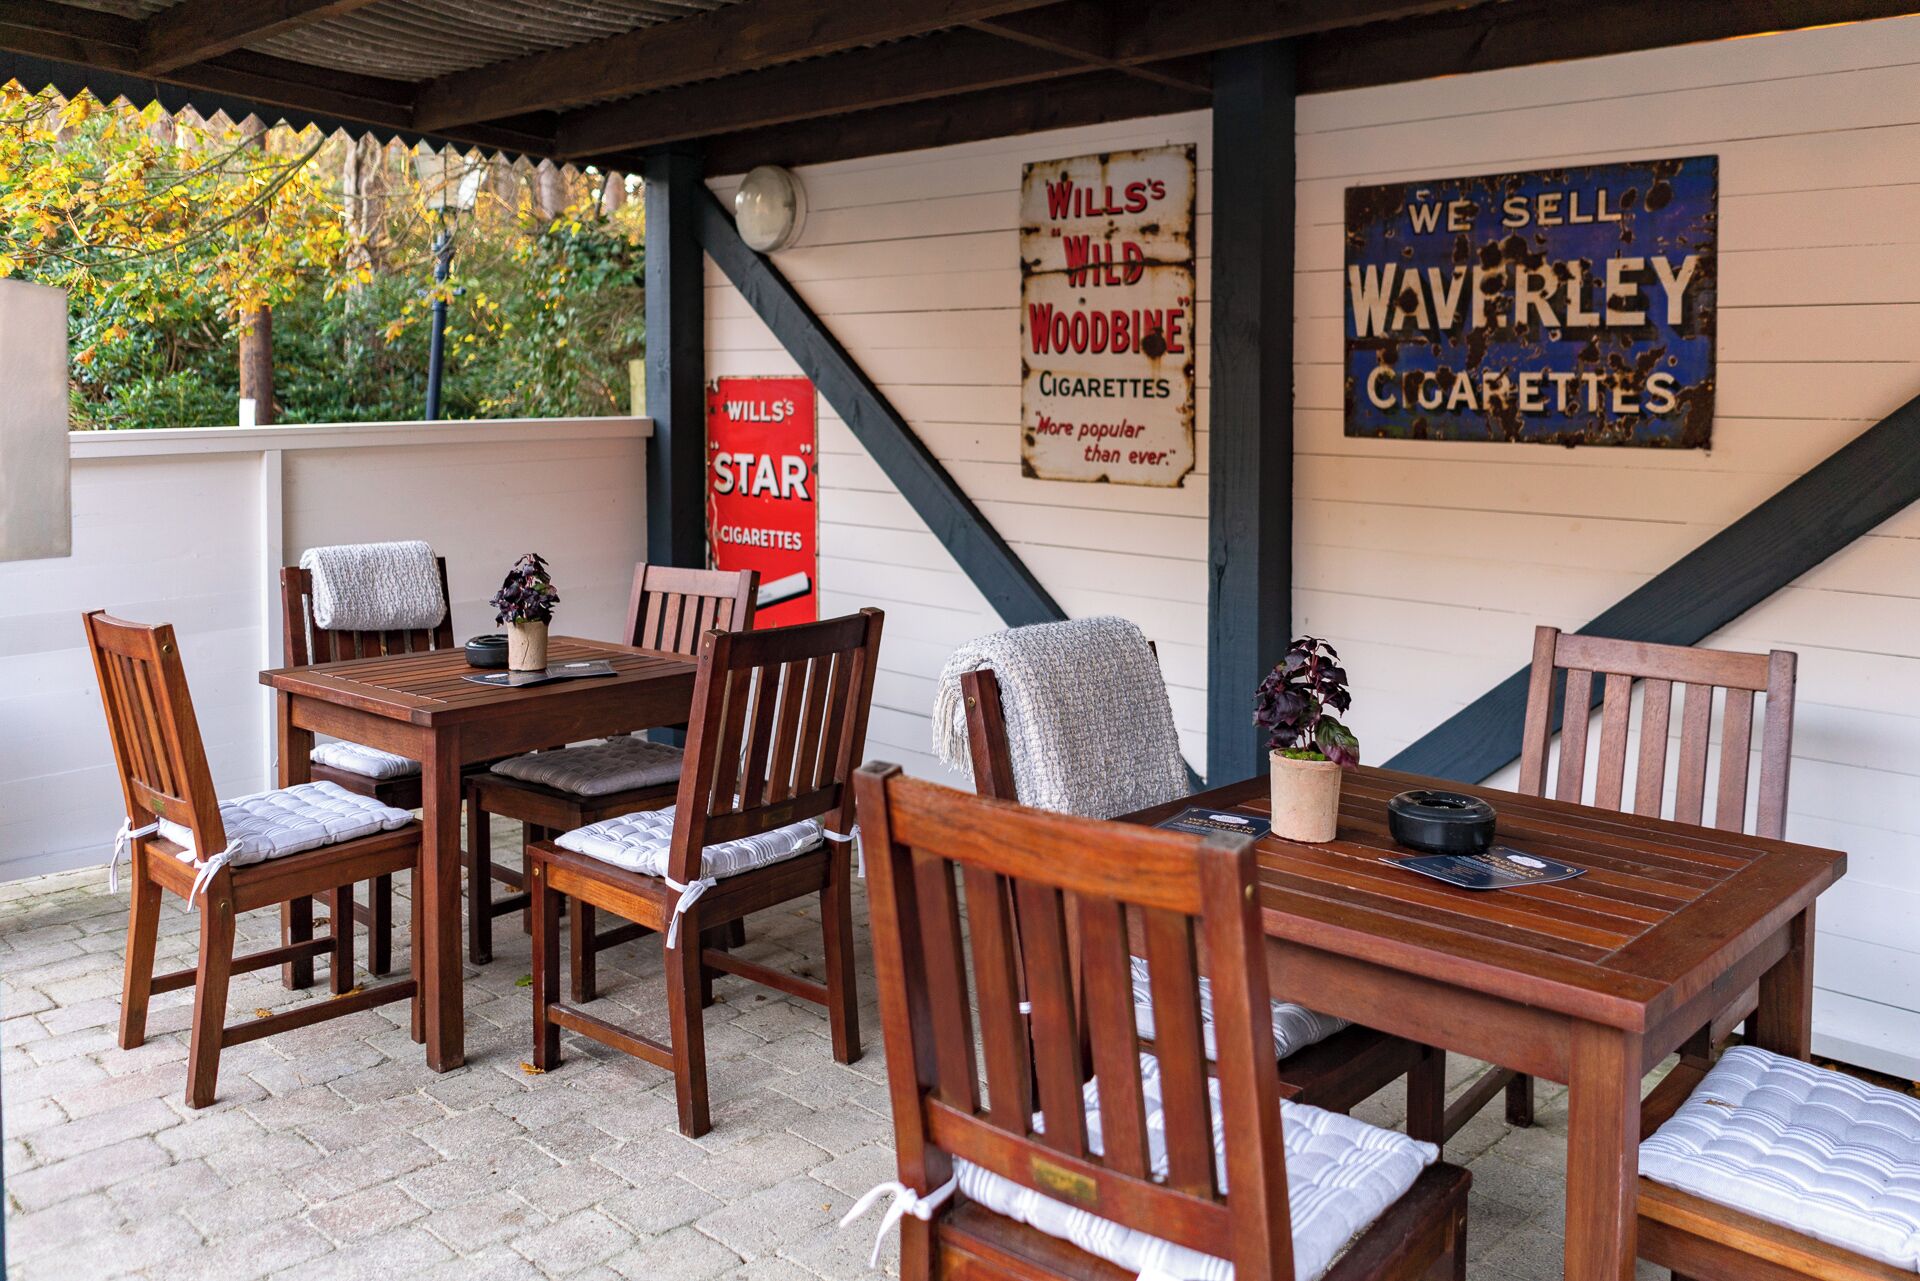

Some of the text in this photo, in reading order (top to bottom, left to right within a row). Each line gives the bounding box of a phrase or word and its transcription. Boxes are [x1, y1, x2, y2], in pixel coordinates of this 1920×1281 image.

[1408, 189, 1622, 234] WE SELL
[1348, 254, 1700, 338] WAVERLEY
[1039, 370, 1170, 398] CIGARETTES
[1367, 365, 1676, 414] CIGARETTES
[1077, 419, 1145, 442] popular
[1084, 444, 1120, 463] than
[720, 525, 803, 550] CIGARETTES
